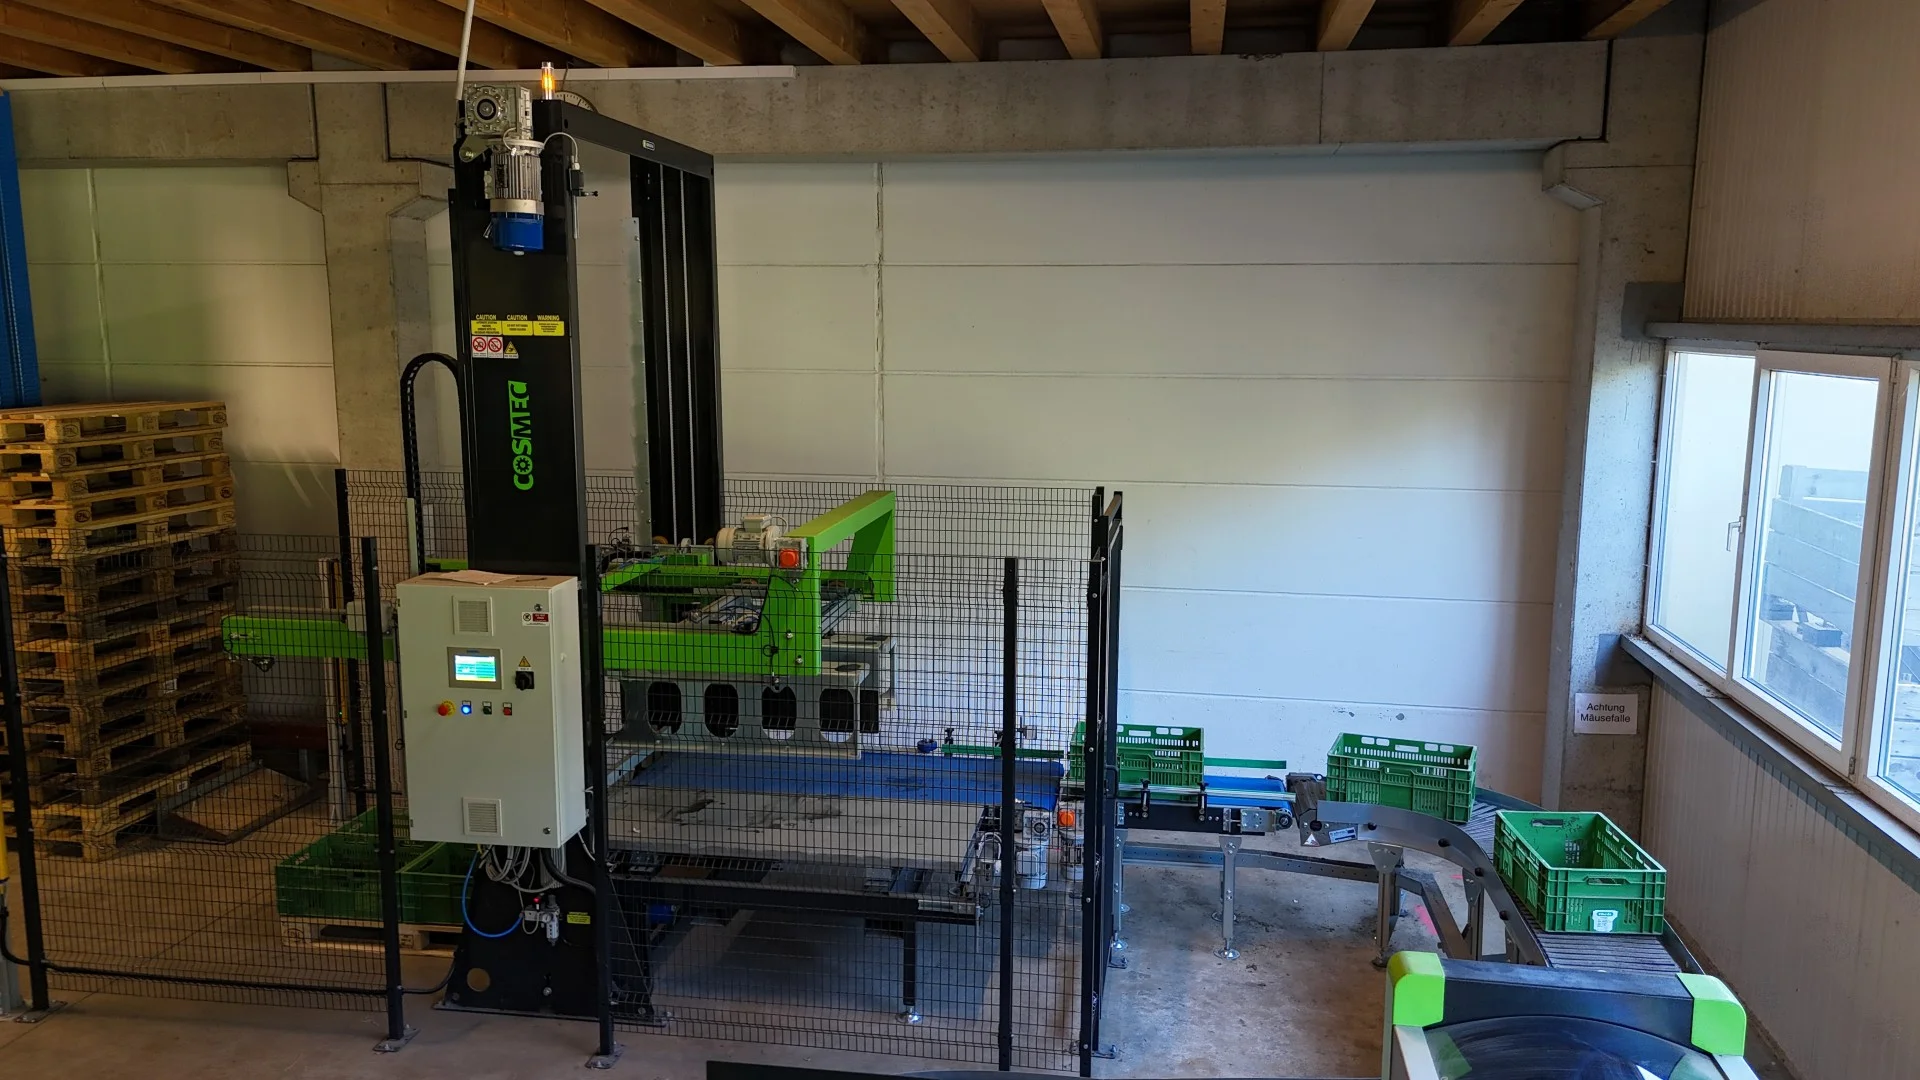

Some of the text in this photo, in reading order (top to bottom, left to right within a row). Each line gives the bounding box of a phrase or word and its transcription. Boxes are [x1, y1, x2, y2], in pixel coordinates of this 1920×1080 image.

[507, 380, 534, 490] COSMEC
[1586, 703, 1625, 713] Achtung
[1580, 713, 1631, 723] Mäusefalle
